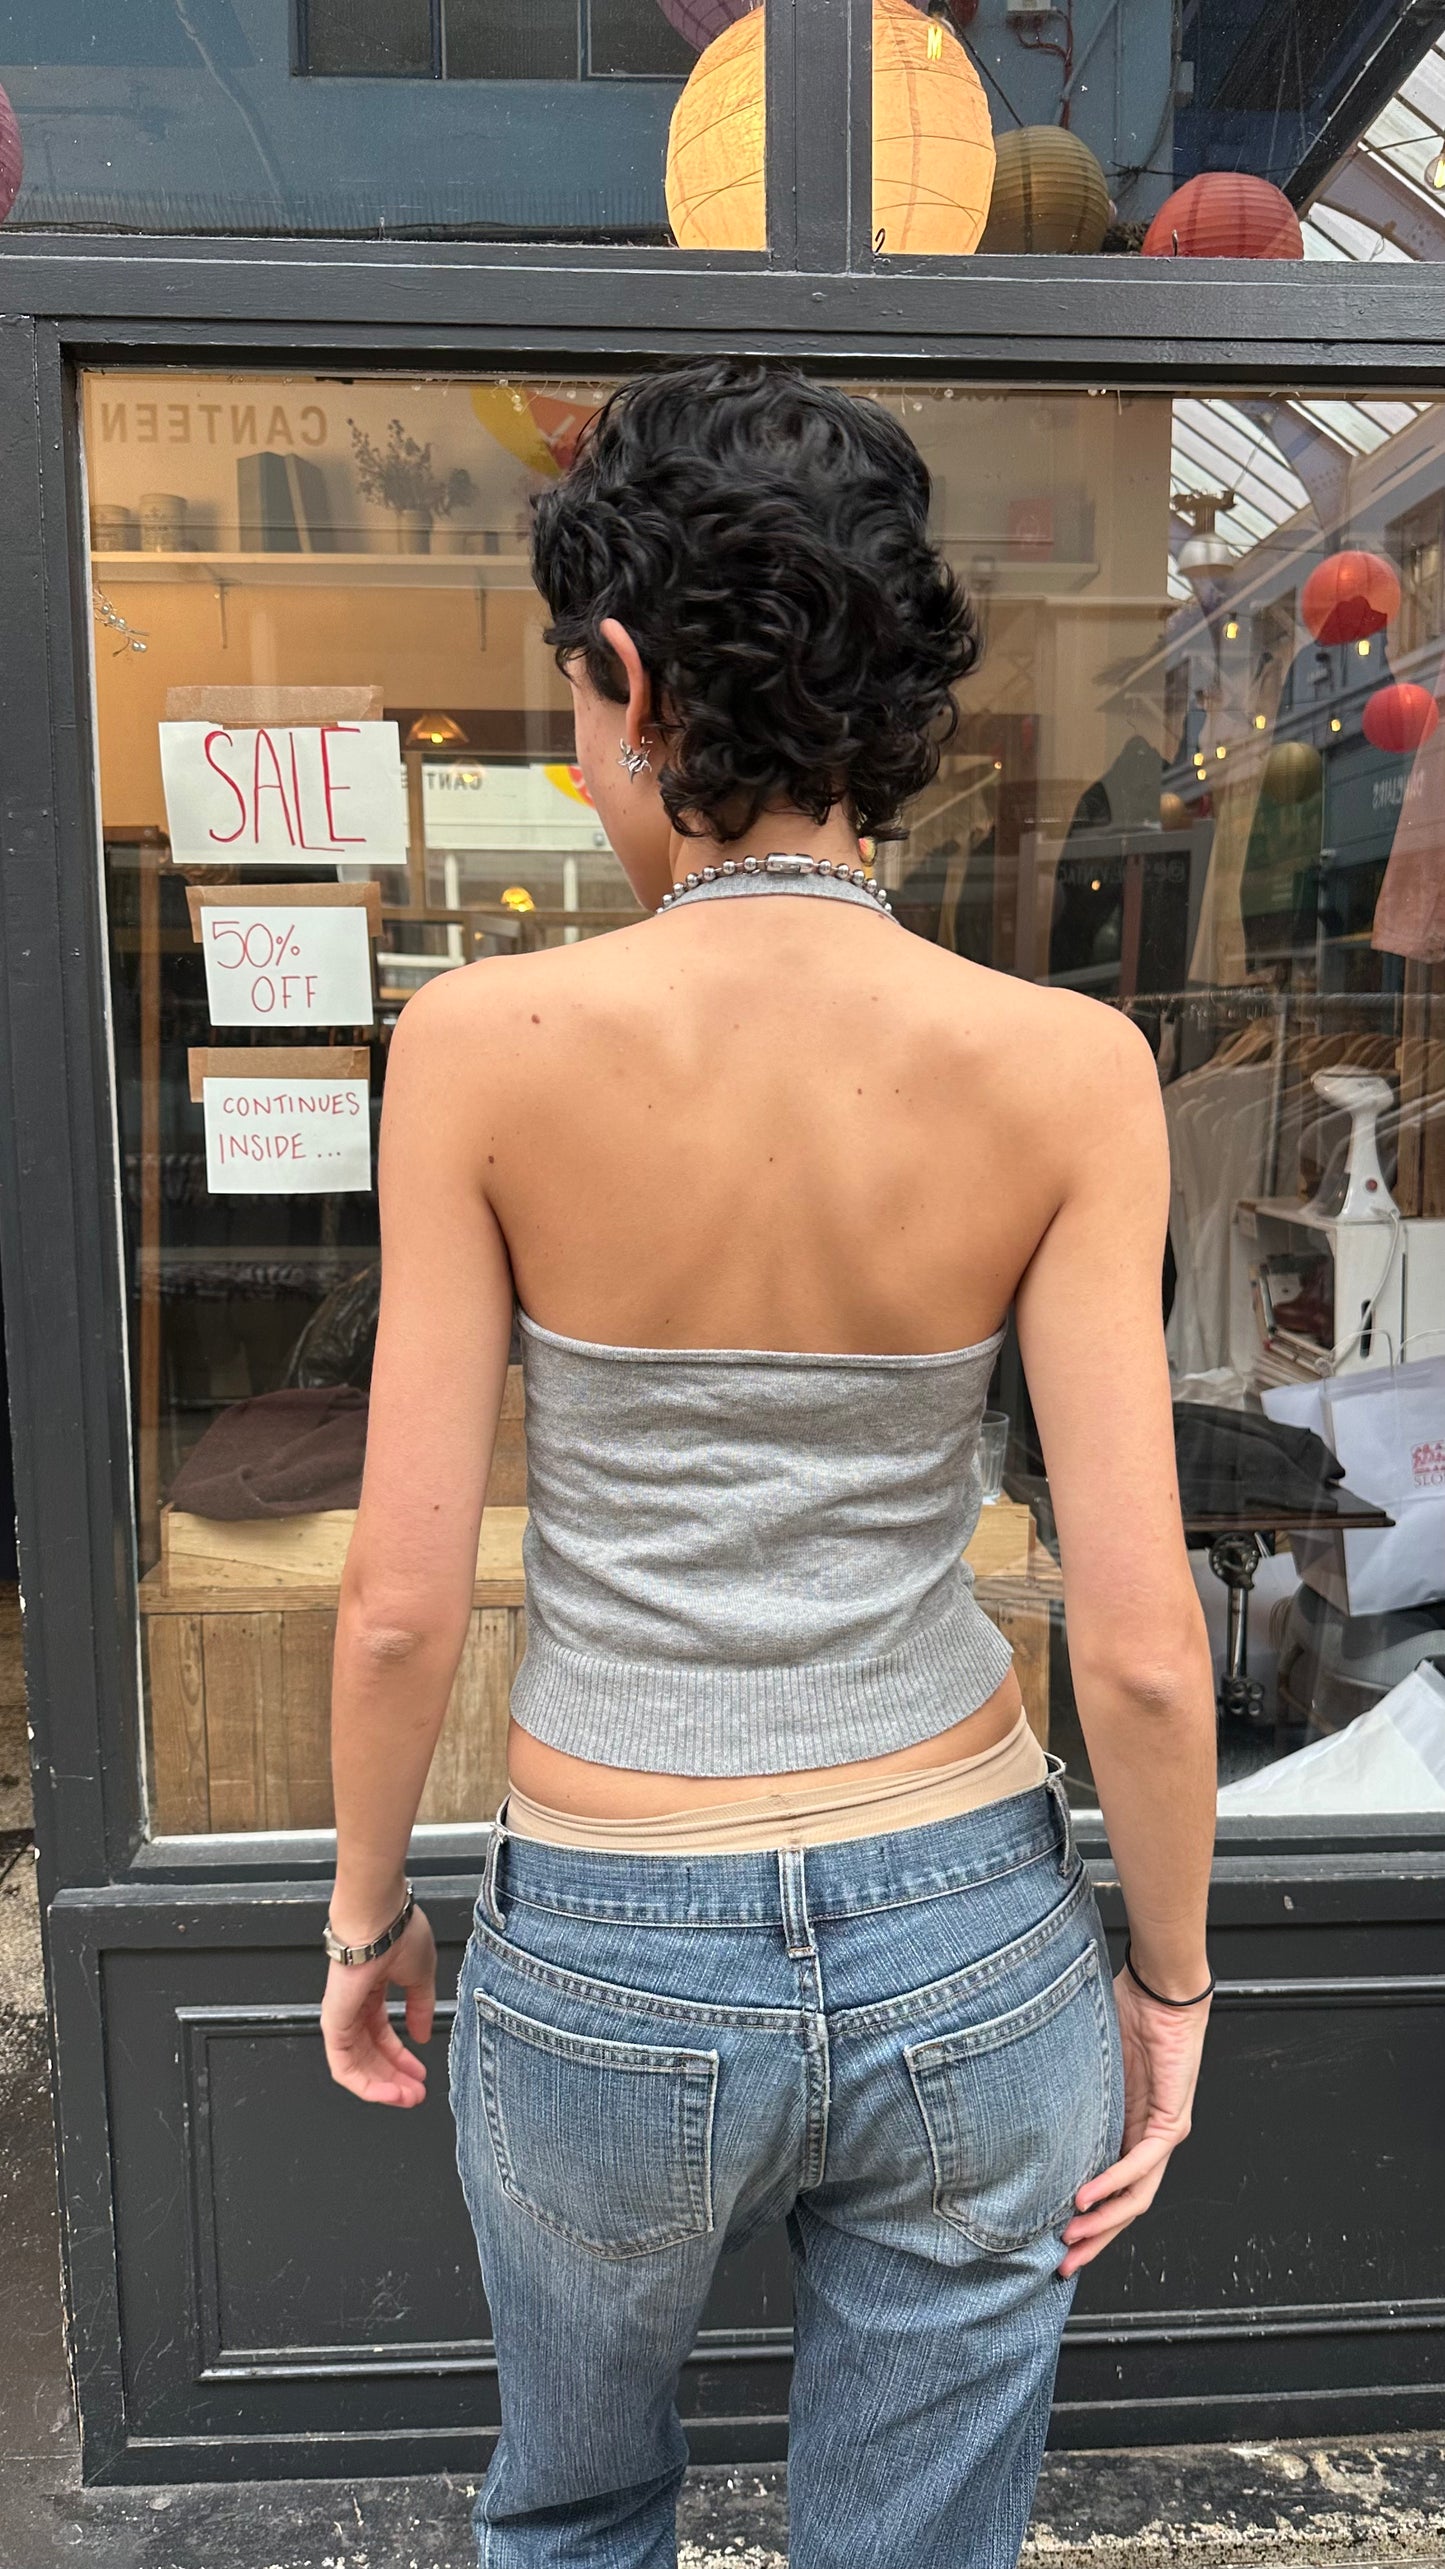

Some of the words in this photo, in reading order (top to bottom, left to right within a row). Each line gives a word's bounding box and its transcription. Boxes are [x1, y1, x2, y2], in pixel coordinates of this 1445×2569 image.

[204, 727, 367, 852] SALE
[212, 921, 301, 969] 50%
[252, 975, 319, 1013] OFF
[223, 1091, 361, 1117] CONTINUES
[1414, 1473, 1445, 1489] SLO
